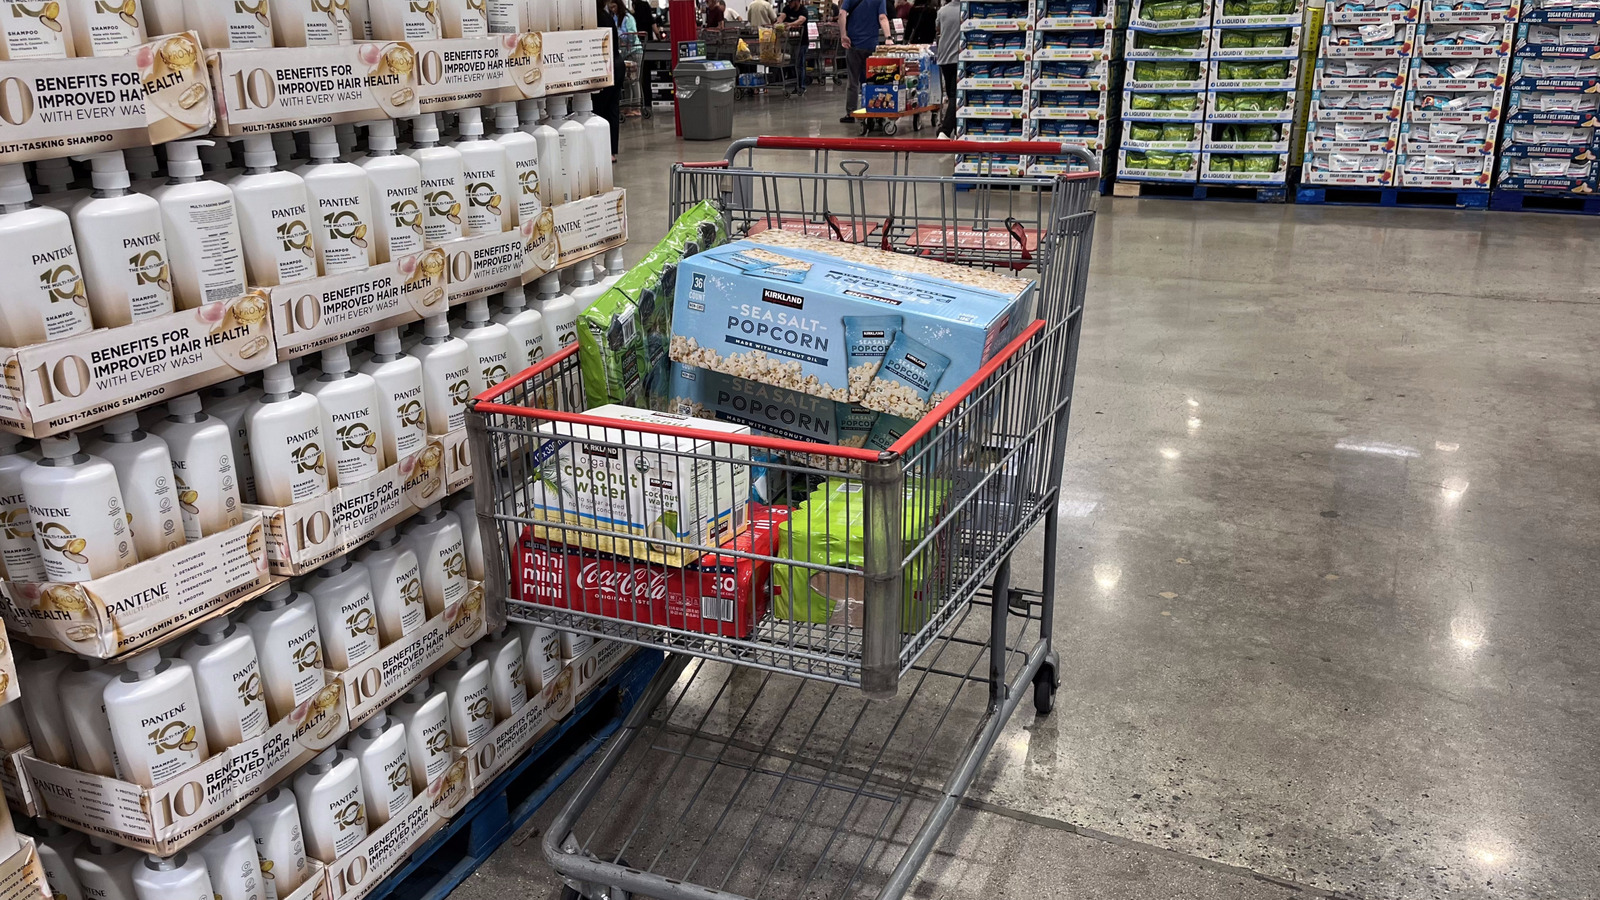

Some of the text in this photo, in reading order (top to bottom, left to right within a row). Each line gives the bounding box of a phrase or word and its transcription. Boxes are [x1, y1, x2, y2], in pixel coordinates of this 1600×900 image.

[444, 49, 499, 62] BENEFITS FOR
[444, 56, 531, 74] IMPROVED HEALTH
[36, 71, 140, 92] BENEFITS FOR
[141, 71, 184, 96] HEALTH
[276, 64, 352, 81] BENEFITS FOR
[278, 74, 399, 95] IMPROVED HAIR HEALTH
[445, 74, 462, 84] WITH
[464, 72, 485, 82] EVERY
[0, 77, 34, 126] 0
[38, 91, 116, 109] IMPROVED
[229, 68, 276, 111] 10
[279, 91, 362, 107] WITH EVERY WASH
[457, 92, 482, 100] SHAMPOO
[40, 104, 146, 124] WITH EVERY WAS
[242, 117, 332, 133] MULTI-TASKING SHAMPOO
[0, 134, 113, 153] ULTI-TASKING SHAMPOO
[272, 204, 306, 218] PANTENE
[319, 196, 359, 207] PANTENE
[554, 219, 581, 234] PANTENE
[123, 232, 161, 249] PANTENE
[32, 244, 74, 266] PANTENE
[322, 277, 391, 304] BENEFITS FOR
[694, 276, 703, 289] 36
[323, 277, 432, 316] IMPROVED HAIR HEALTH
[689, 291, 705, 301] COUNT
[764, 290, 802, 305] KIRKLAND
[845, 291, 898, 305] KIRKLAND
[280, 294, 321, 337] 10
[324, 298, 399, 326] WITH EVERY WASH
[740, 304, 819, 332] SEA SALT
[91, 327, 190, 364] BENEFITS FOR
[288, 326, 370, 355] MULTI-TASKING SHAMPOO
[727, 316, 829, 352] POPCORN
[94, 325, 250, 379] IMPROVED HAIR HEALTH
[735, 339, 818, 363] MADE WITH COCONUT OIL
[906, 354, 927, 368] KIRKLAND
[30, 354, 91, 409] 10
[96, 353, 203, 391] WITH EVERY WASH
[888, 360, 931, 388] POPCORN
[49, 387, 165, 428] MULTI-TASKING SHAMPOO
[732, 378, 821, 412] SEA SALT
[332, 408, 370, 422] PANTENE
[718, 390, 830, 436] POPCORN
[286, 427, 319, 445] PANTENE
[727, 415, 746, 425] MADE
[749, 421, 767, 431] WITH
[769, 426, 803, 440] COCONUT
[29, 505, 71, 517] PANTENE
[332, 481, 393, 516] BENEFITS FOR
[332, 471, 430, 529] IMPROVED HAIR HEALTH
[353, 498, 400, 531] EVERY WASH
[292, 510, 331, 552] 10
[177, 552, 206, 566] MOISTURIZES
[300, 530, 375, 569] MULTI-TASKING SHAMPOO
[525, 552, 563, 568] mini
[180, 565, 218, 585] PROTECTS COLOR
[524, 567, 562, 584] mini
[577, 562, 674, 600] Coca-Cola
[711, 577, 735, 592] 30
[106, 581, 169, 618] PANTENE
[524, 583, 562, 598] mini
[29, 609, 72, 620] HEALTH
[118, 620, 173, 648] PRO-VITAMIN
[188, 597, 224, 617] KERATIN,
[225, 582, 254, 600] VITAMIN
[255, 579, 260, 588] E
[446, 614, 471, 637] HEALTH
[288, 624, 317, 648] PANTENE
[382, 628, 439, 670] BENEFITS FOR
[349, 667, 382, 710] 10
[142, 702, 186, 728] PANTENE
[206, 733, 283, 784] BENEFITS FOR
[207, 710, 326, 796] IMPROVED HAIR HEALTH
[156, 780, 204, 830] 10
[430, 785, 456, 815] HEALTH
[167, 787, 260, 845] MULTI-TASKING SHAMPOO
[368, 806, 423, 856] BENEFITS FOR
[333, 856, 367, 895] 10
